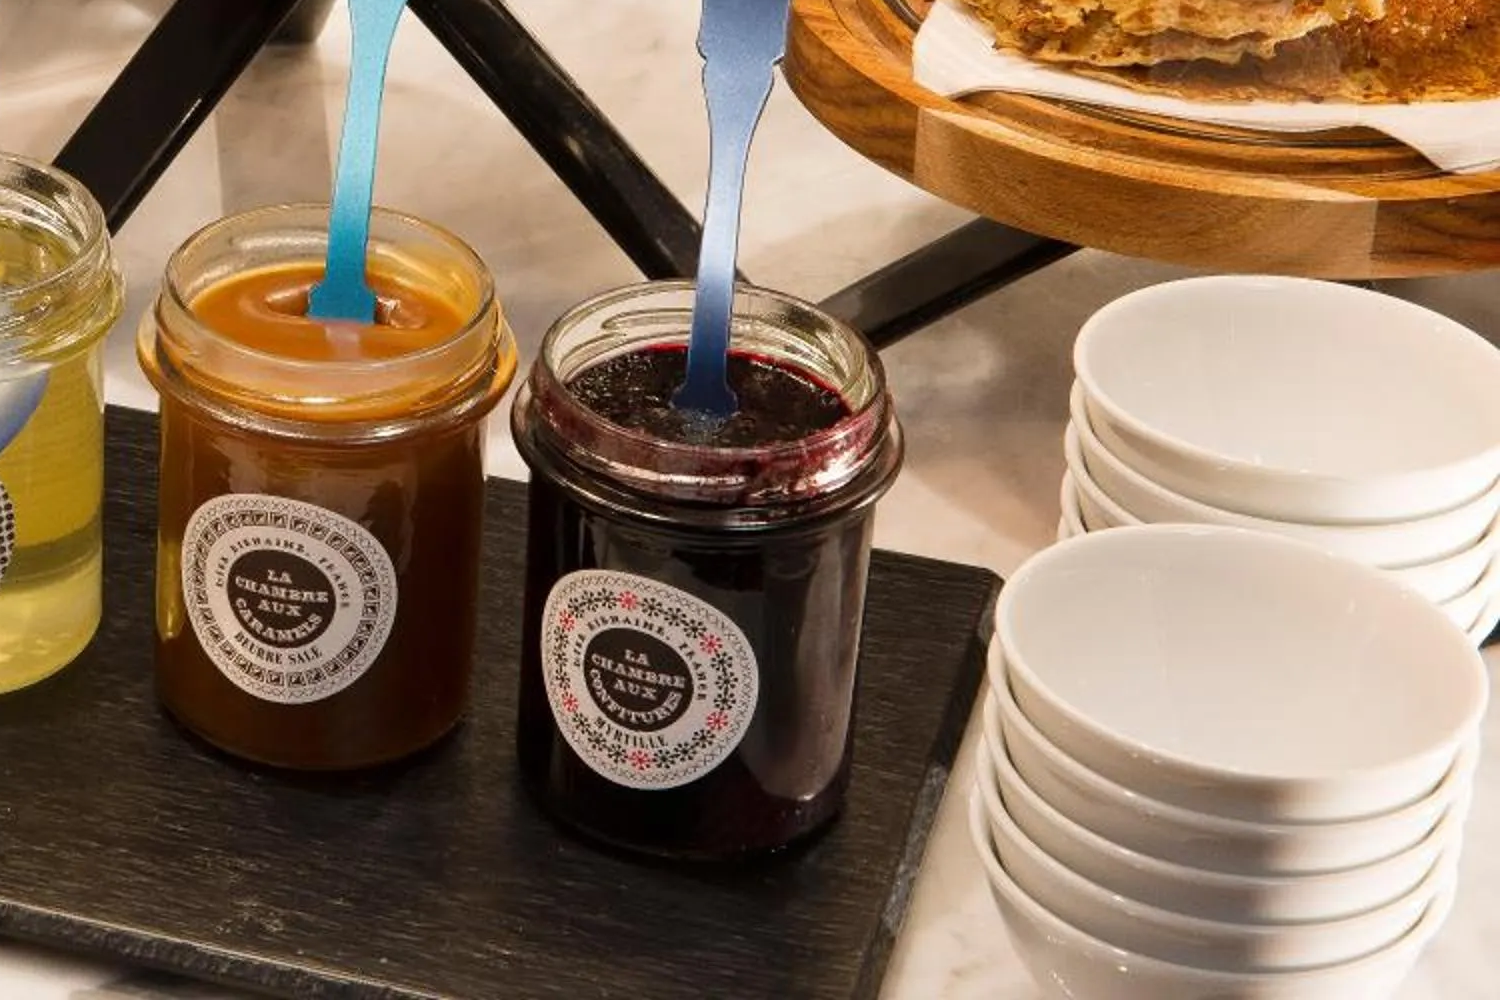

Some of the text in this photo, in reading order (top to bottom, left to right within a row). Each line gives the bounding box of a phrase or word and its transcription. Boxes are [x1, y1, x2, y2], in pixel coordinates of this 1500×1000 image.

[235, 576, 329, 603] CHAMBRE
[267, 568, 292, 584] LA
[235, 597, 323, 641] CARAMELS
[257, 599, 302, 617] AUX
[234, 631, 283, 664] BEURRE
[624, 649, 649, 665] LA
[591, 653, 687, 689] CHAMBRE
[590, 669, 683, 723] CONFITURES
[613, 678, 657, 700] AUX
[594, 717, 669, 748] MYRTILLE
